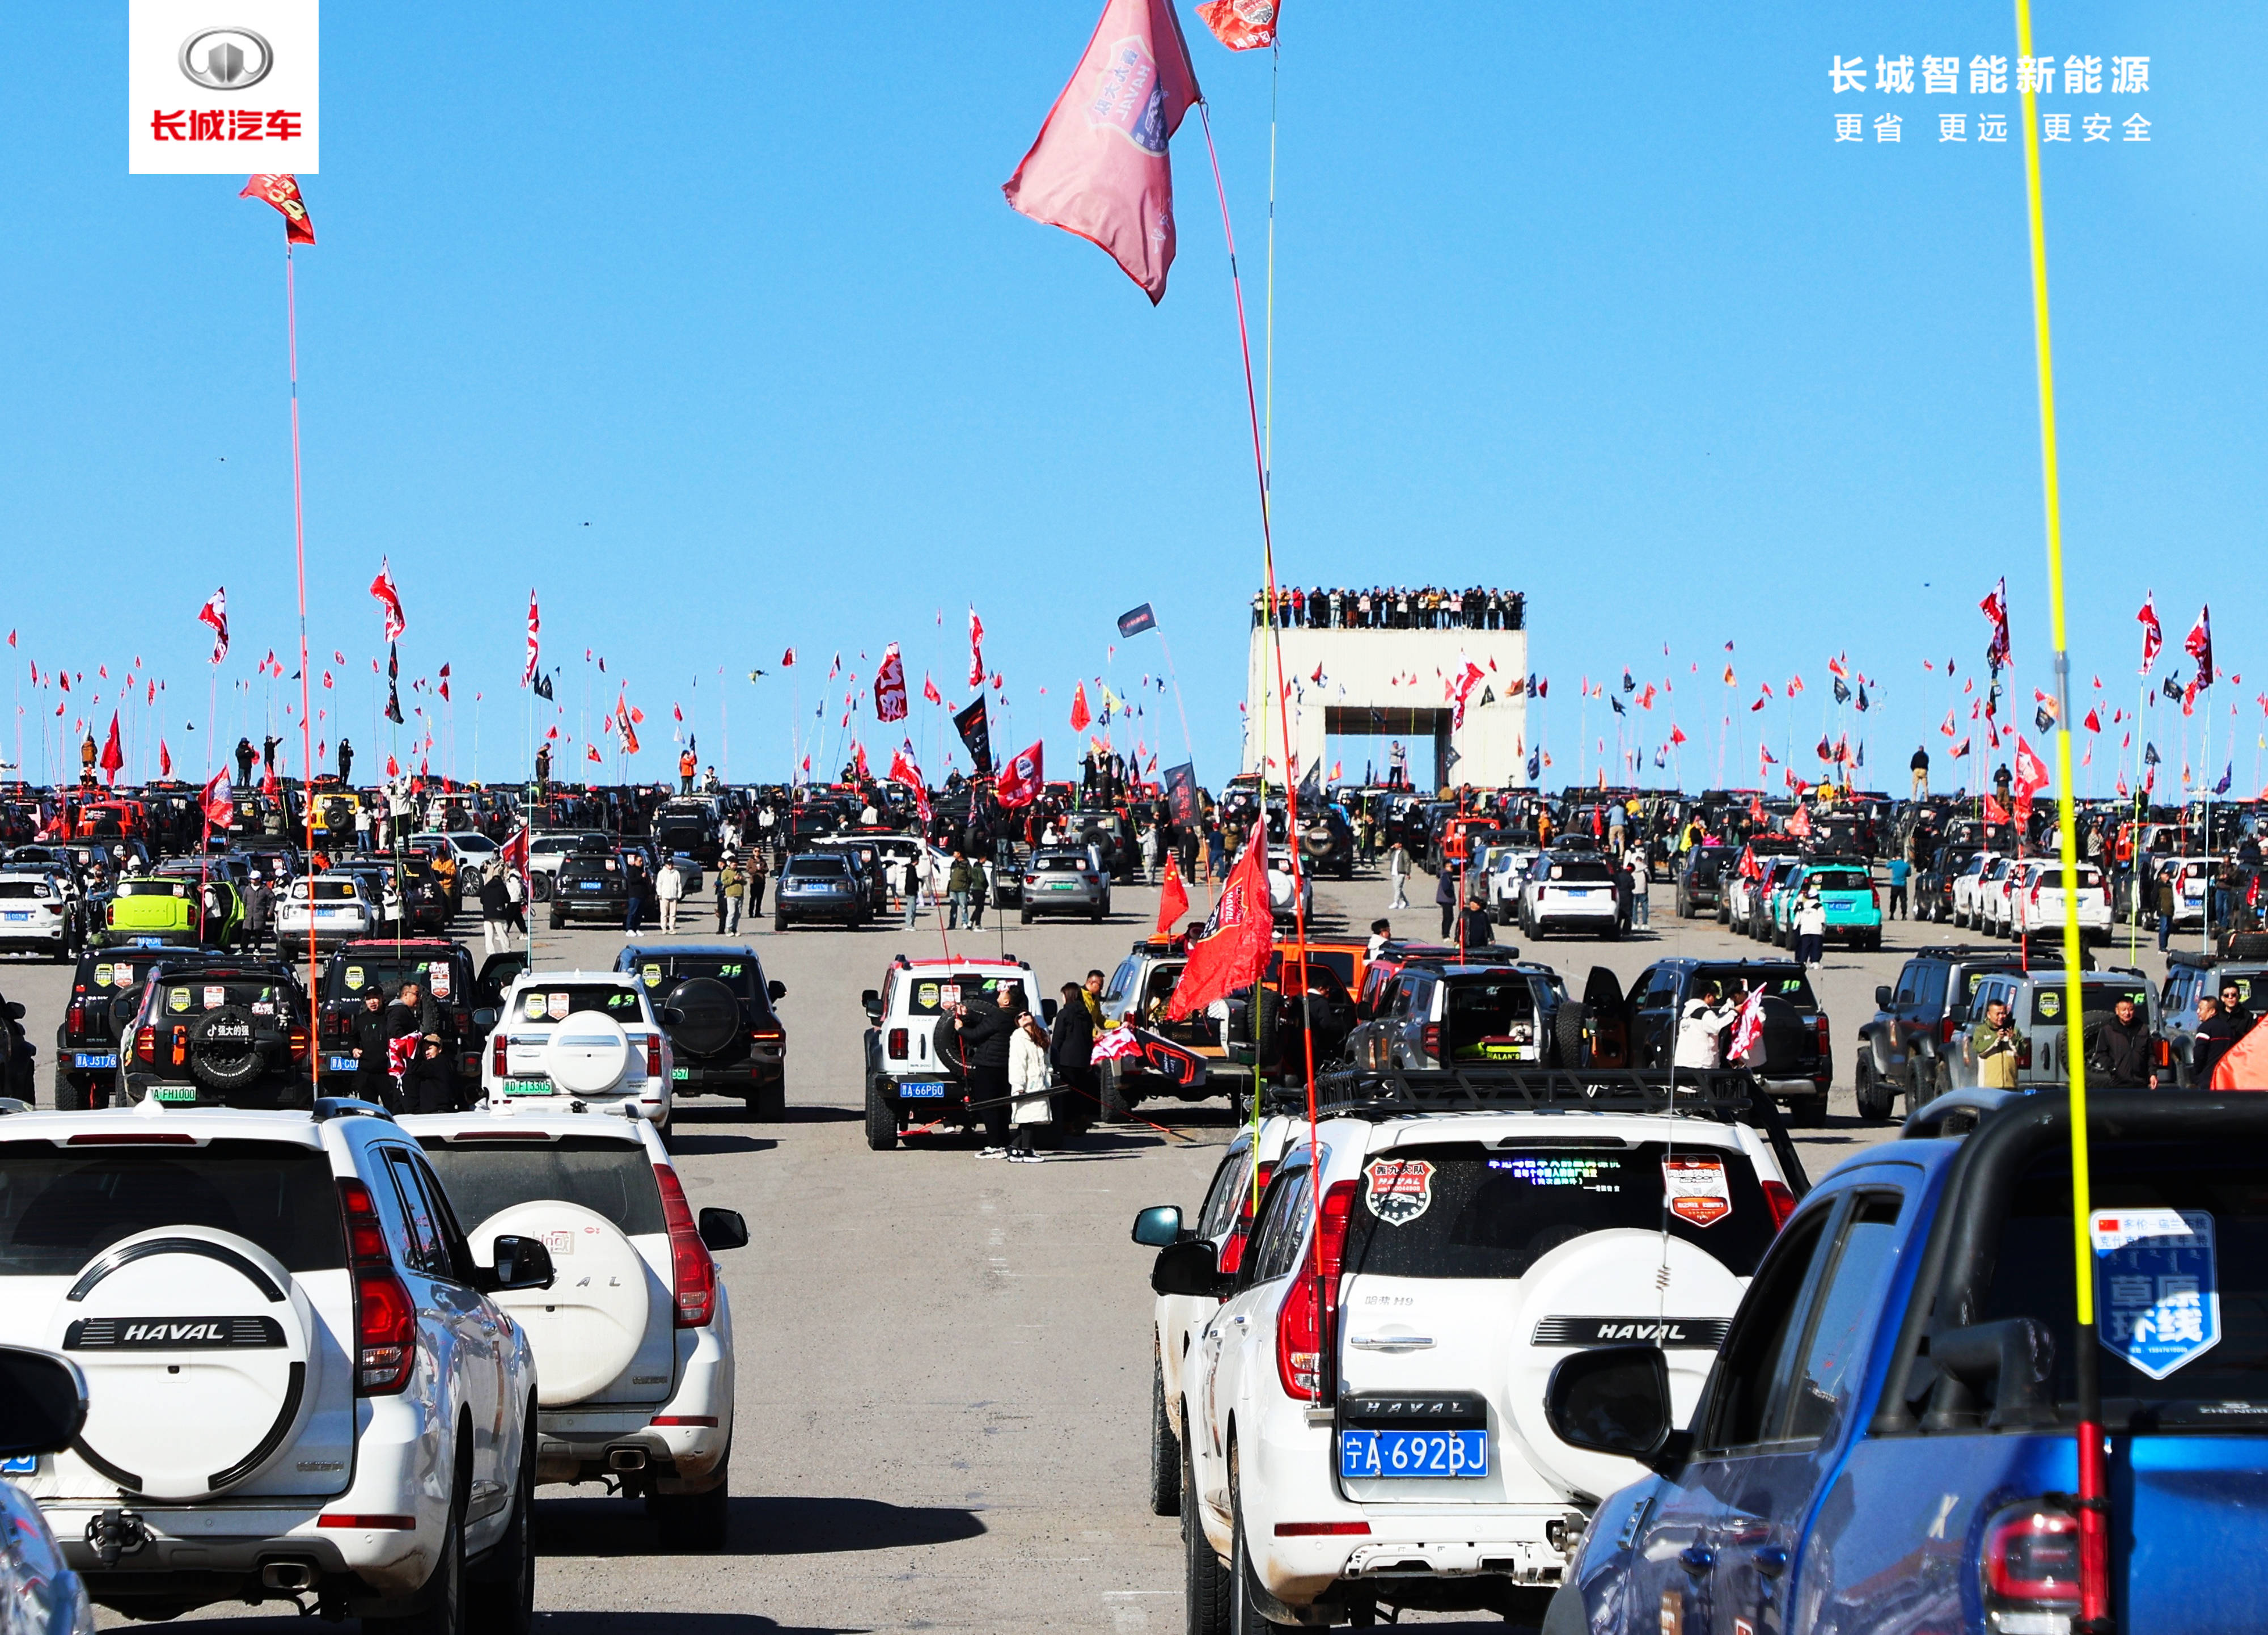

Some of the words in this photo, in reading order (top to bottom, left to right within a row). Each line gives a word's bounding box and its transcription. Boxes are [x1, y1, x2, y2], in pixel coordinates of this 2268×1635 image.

[1782, 980, 1800, 992] 10
[608, 994, 635, 1007] 43
[218, 1025, 249, 1036] 强大的强
[1376, 1165, 1425, 1175] 轰九大队
[2110, 1276, 2201, 1308] 草原
[1395, 1296, 1414, 1306] H9
[124, 1324, 225, 1341] HAVAL
[1597, 1324, 1686, 1340] HAVAL
[2113, 1309, 2203, 1343] 环线
[1365, 1401, 1464, 1414] HAVAL
[1345, 1435, 1487, 1472] 宁A·692BJ
